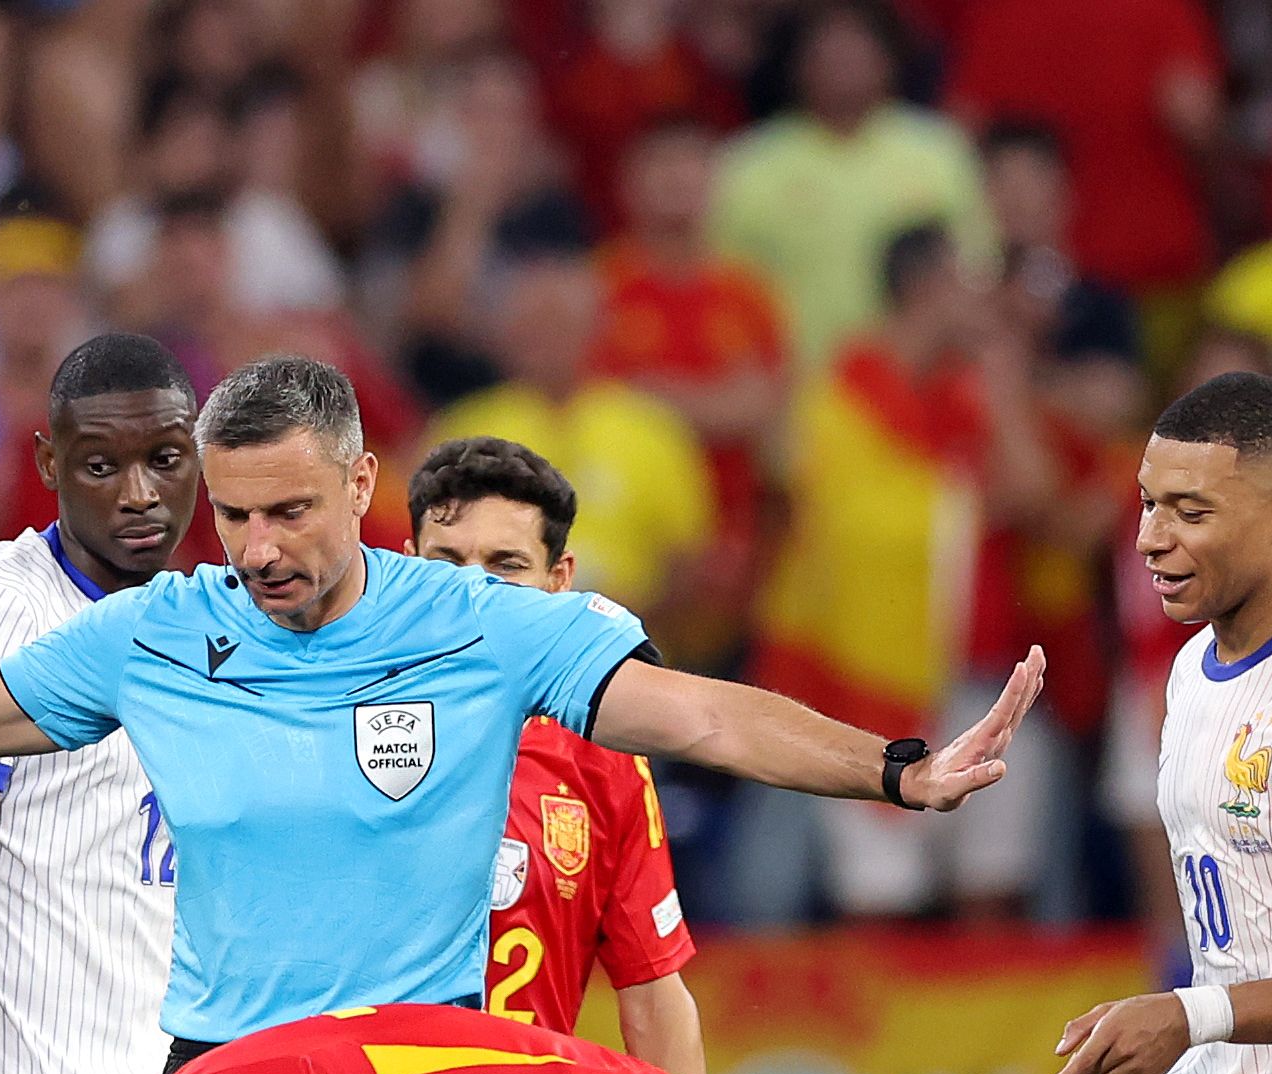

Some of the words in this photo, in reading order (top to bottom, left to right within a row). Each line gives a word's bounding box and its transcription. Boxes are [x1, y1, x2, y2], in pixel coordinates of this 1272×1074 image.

[370, 714, 416, 732] UEFA
[372, 743, 418, 754] MATCH
[367, 757, 424, 770] OFFICIAL
[1184, 854, 1233, 952] 10
